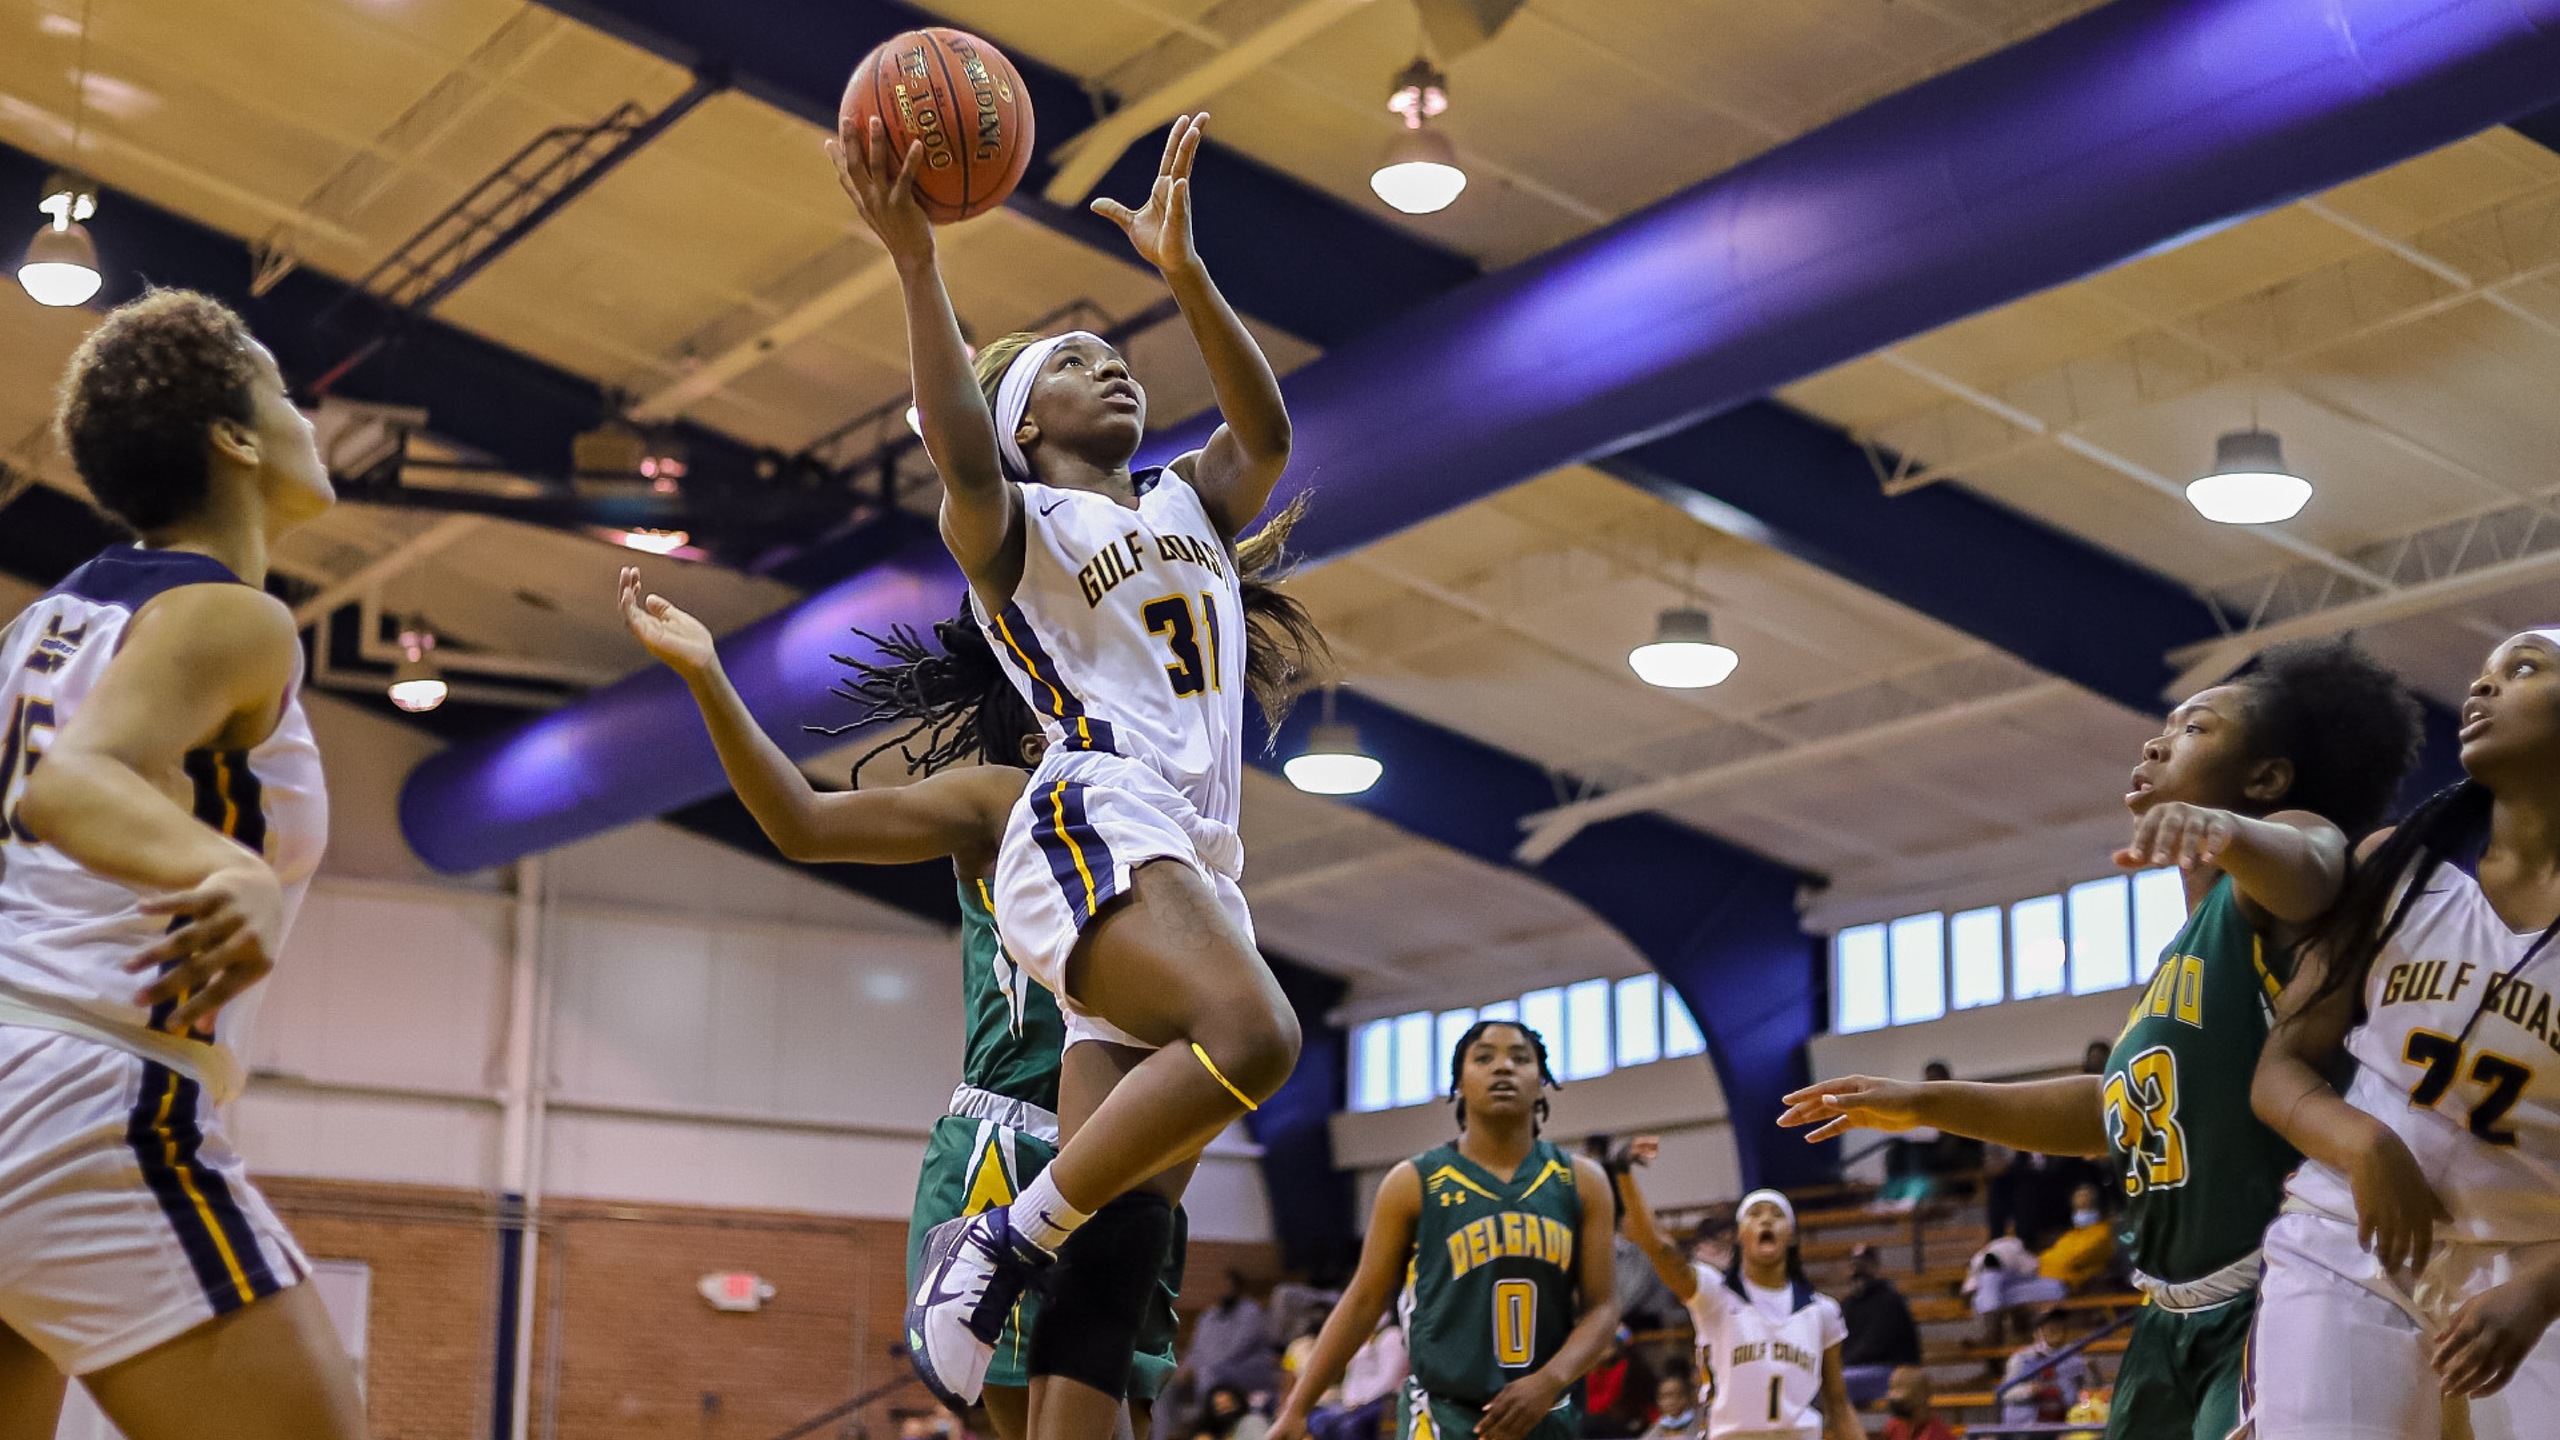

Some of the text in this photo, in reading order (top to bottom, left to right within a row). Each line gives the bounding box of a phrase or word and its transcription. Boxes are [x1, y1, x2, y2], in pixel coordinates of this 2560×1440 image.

[1077, 530, 1144, 609] GULF
[1140, 592, 1222, 698] 31
[2380, 960, 2477, 1008] GULF
[1446, 1212, 1574, 1282] DELGADO
[1491, 1277, 1539, 1369] 0
[1732, 1341, 1767, 1368] GULF
[1766, 1374, 1784, 1422] 1
